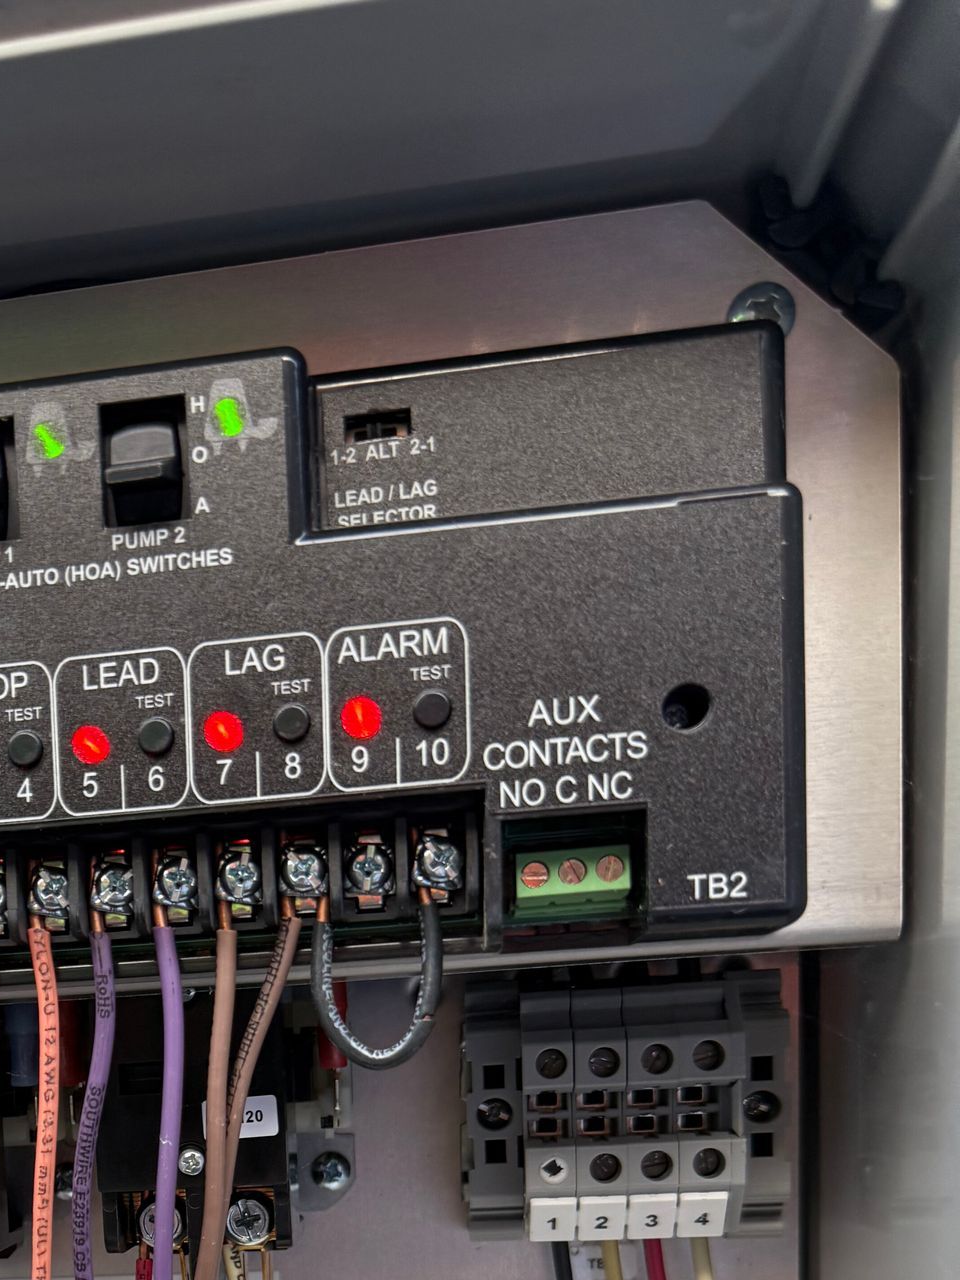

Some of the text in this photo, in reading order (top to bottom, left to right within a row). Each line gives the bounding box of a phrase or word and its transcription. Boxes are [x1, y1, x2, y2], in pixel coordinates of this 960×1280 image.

[190, 396, 205, 413] H
[191, 446, 209, 463] O
[329, 436, 435, 466] 1-2 ALT 2-1
[194, 496, 211, 514] A
[334, 486, 384, 508] LEAD
[398, 479, 438, 500] LAG
[337, 504, 437, 527] SELECTOR
[111, 526, 187, 551] PUMP 2
[4, 546, 14, 563] 1
[64, 563, 122, 587] (HOA)
[126, 547, 234, 577] SWITCHES
[337, 626, 449, 665] ALARM
[224, 644, 287, 676] LAG
[409, 664, 452, 682] TEST
[82, 657, 160, 691] LEAD
[270, 678, 312, 696] TEST
[134, 692, 175, 710] TEST
[527, 695, 602, 729] AUX
[4, 706, 43, 723] TEST
[351, 745, 369, 773] 9
[415, 737, 450, 767] 10
[482, 731, 649, 771] CONTACTS
[215, 759, 233, 785] 7
[284, 752, 302, 779] 8
[16, 778, 33, 803] 4
[81, 772, 99, 798] 5
[147, 766, 165, 792] 6
[498, 770, 633, 808] NO C NC
[687, 871, 749, 900] TB2
[74, 1086, 102, 1187] SOUTHWIRE
[546, 1217, 557, 1231] 1
[594, 1215, 608, 1230] 2
[644, 1214, 659, 1228] 3
[694, 1212, 710, 1226] 4
